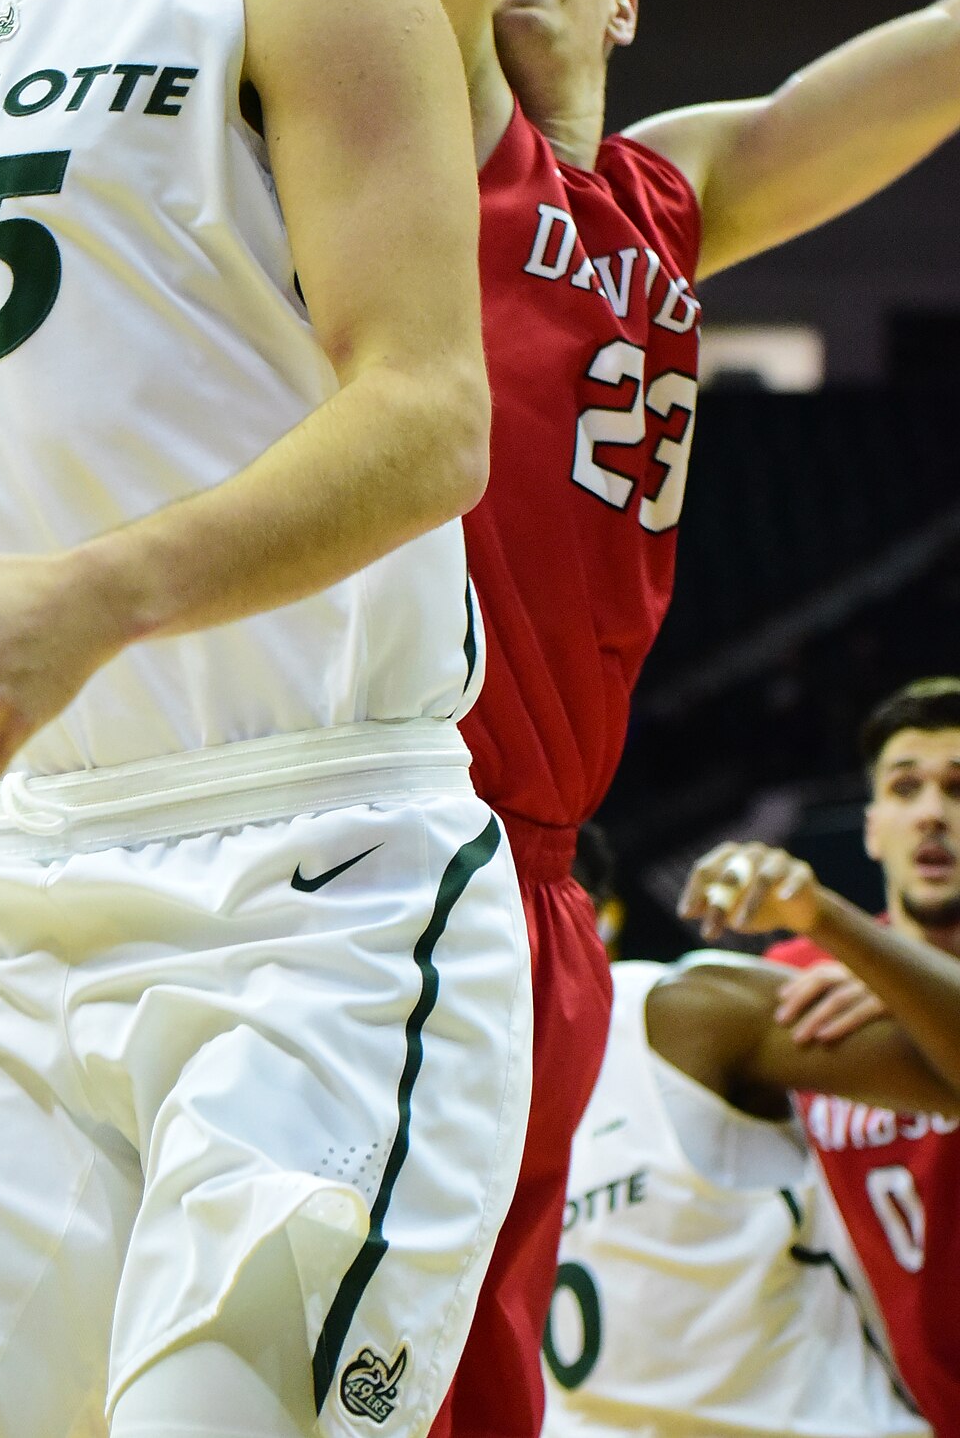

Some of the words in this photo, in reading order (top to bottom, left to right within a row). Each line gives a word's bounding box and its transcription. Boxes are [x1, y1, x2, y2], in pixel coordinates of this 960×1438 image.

[570, 337, 698, 534] 23
[866, 1164, 926, 1273] 0
[543, 1260, 602, 1391] 0
[344, 1380, 390, 1416] 49ERS
